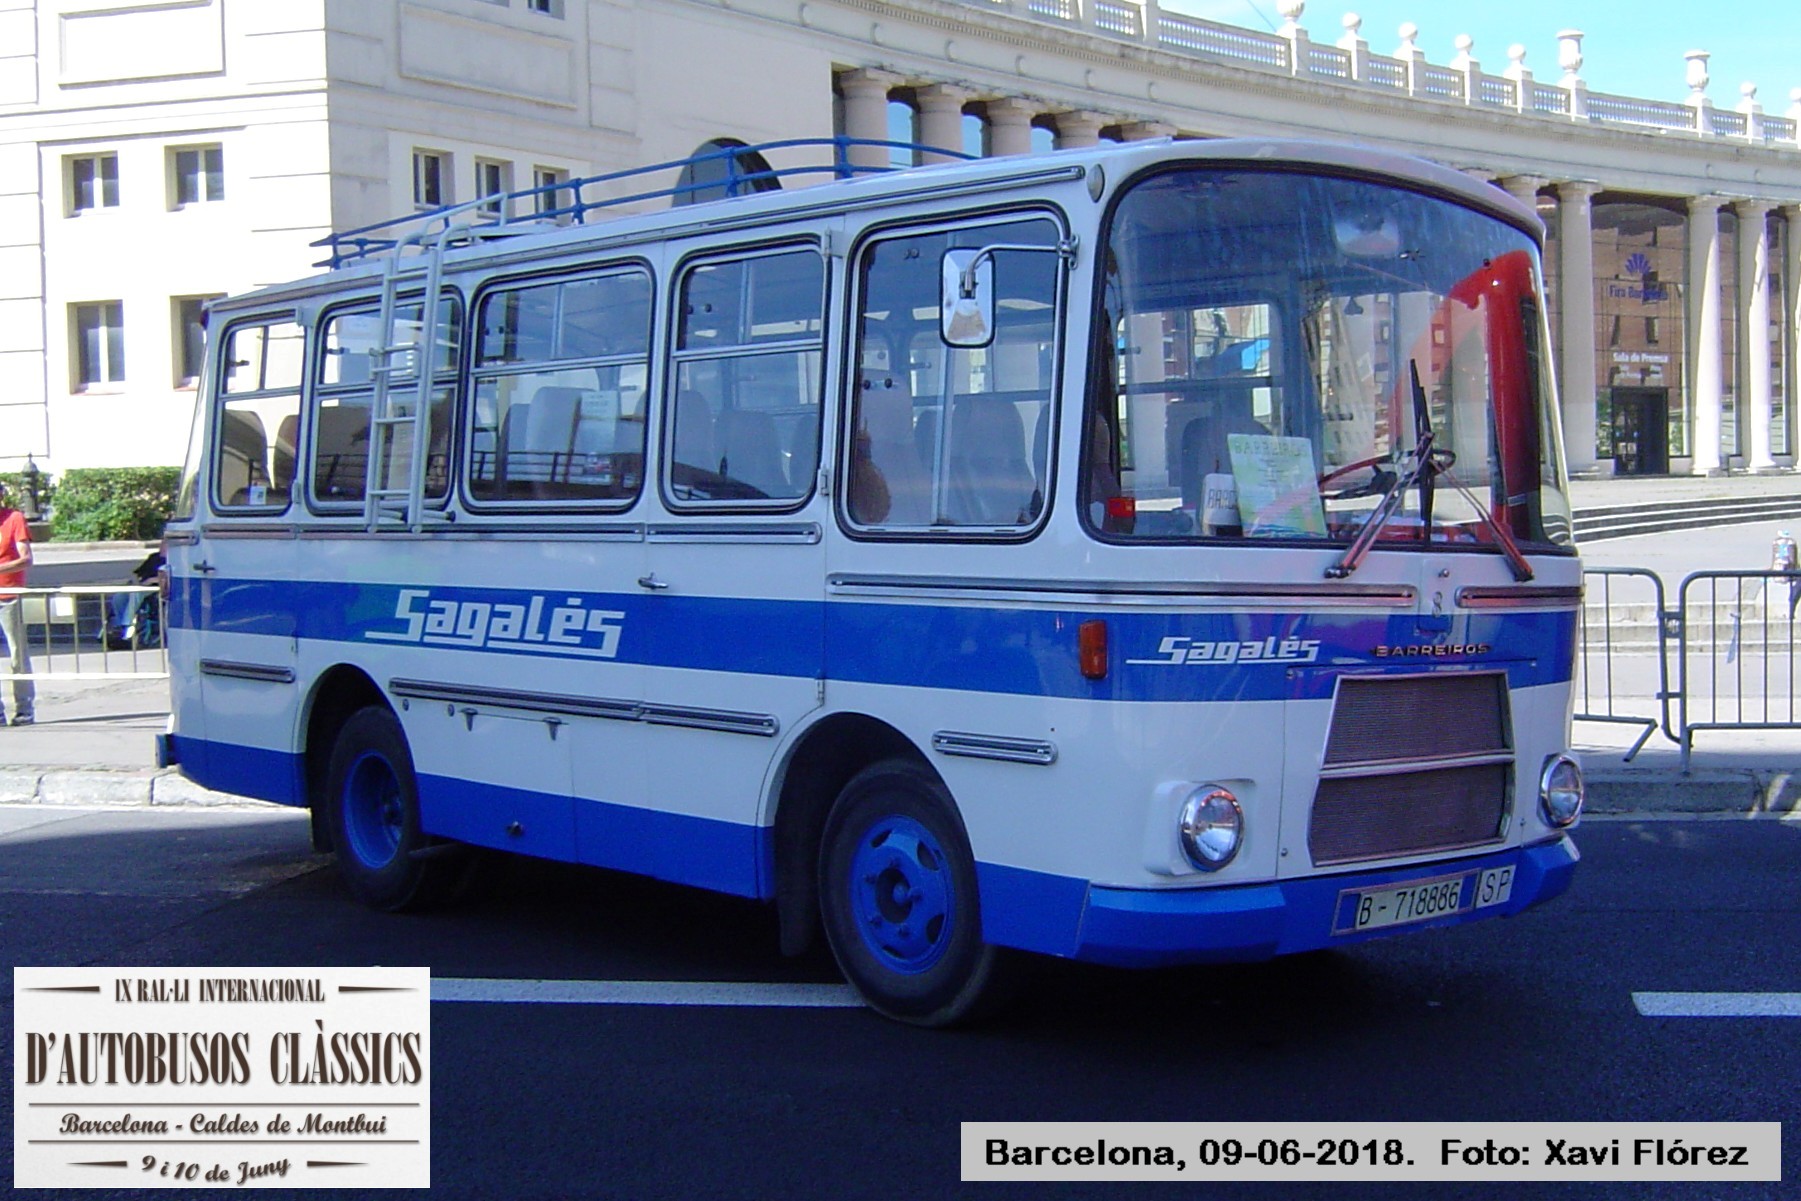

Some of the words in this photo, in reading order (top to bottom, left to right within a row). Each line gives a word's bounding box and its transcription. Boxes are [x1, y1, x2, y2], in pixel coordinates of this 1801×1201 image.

[364, 589, 626, 658] Sagalés
[1126, 636, 1321, 664] Sagalés
[1375, 643, 1488, 657] BARREIROS
